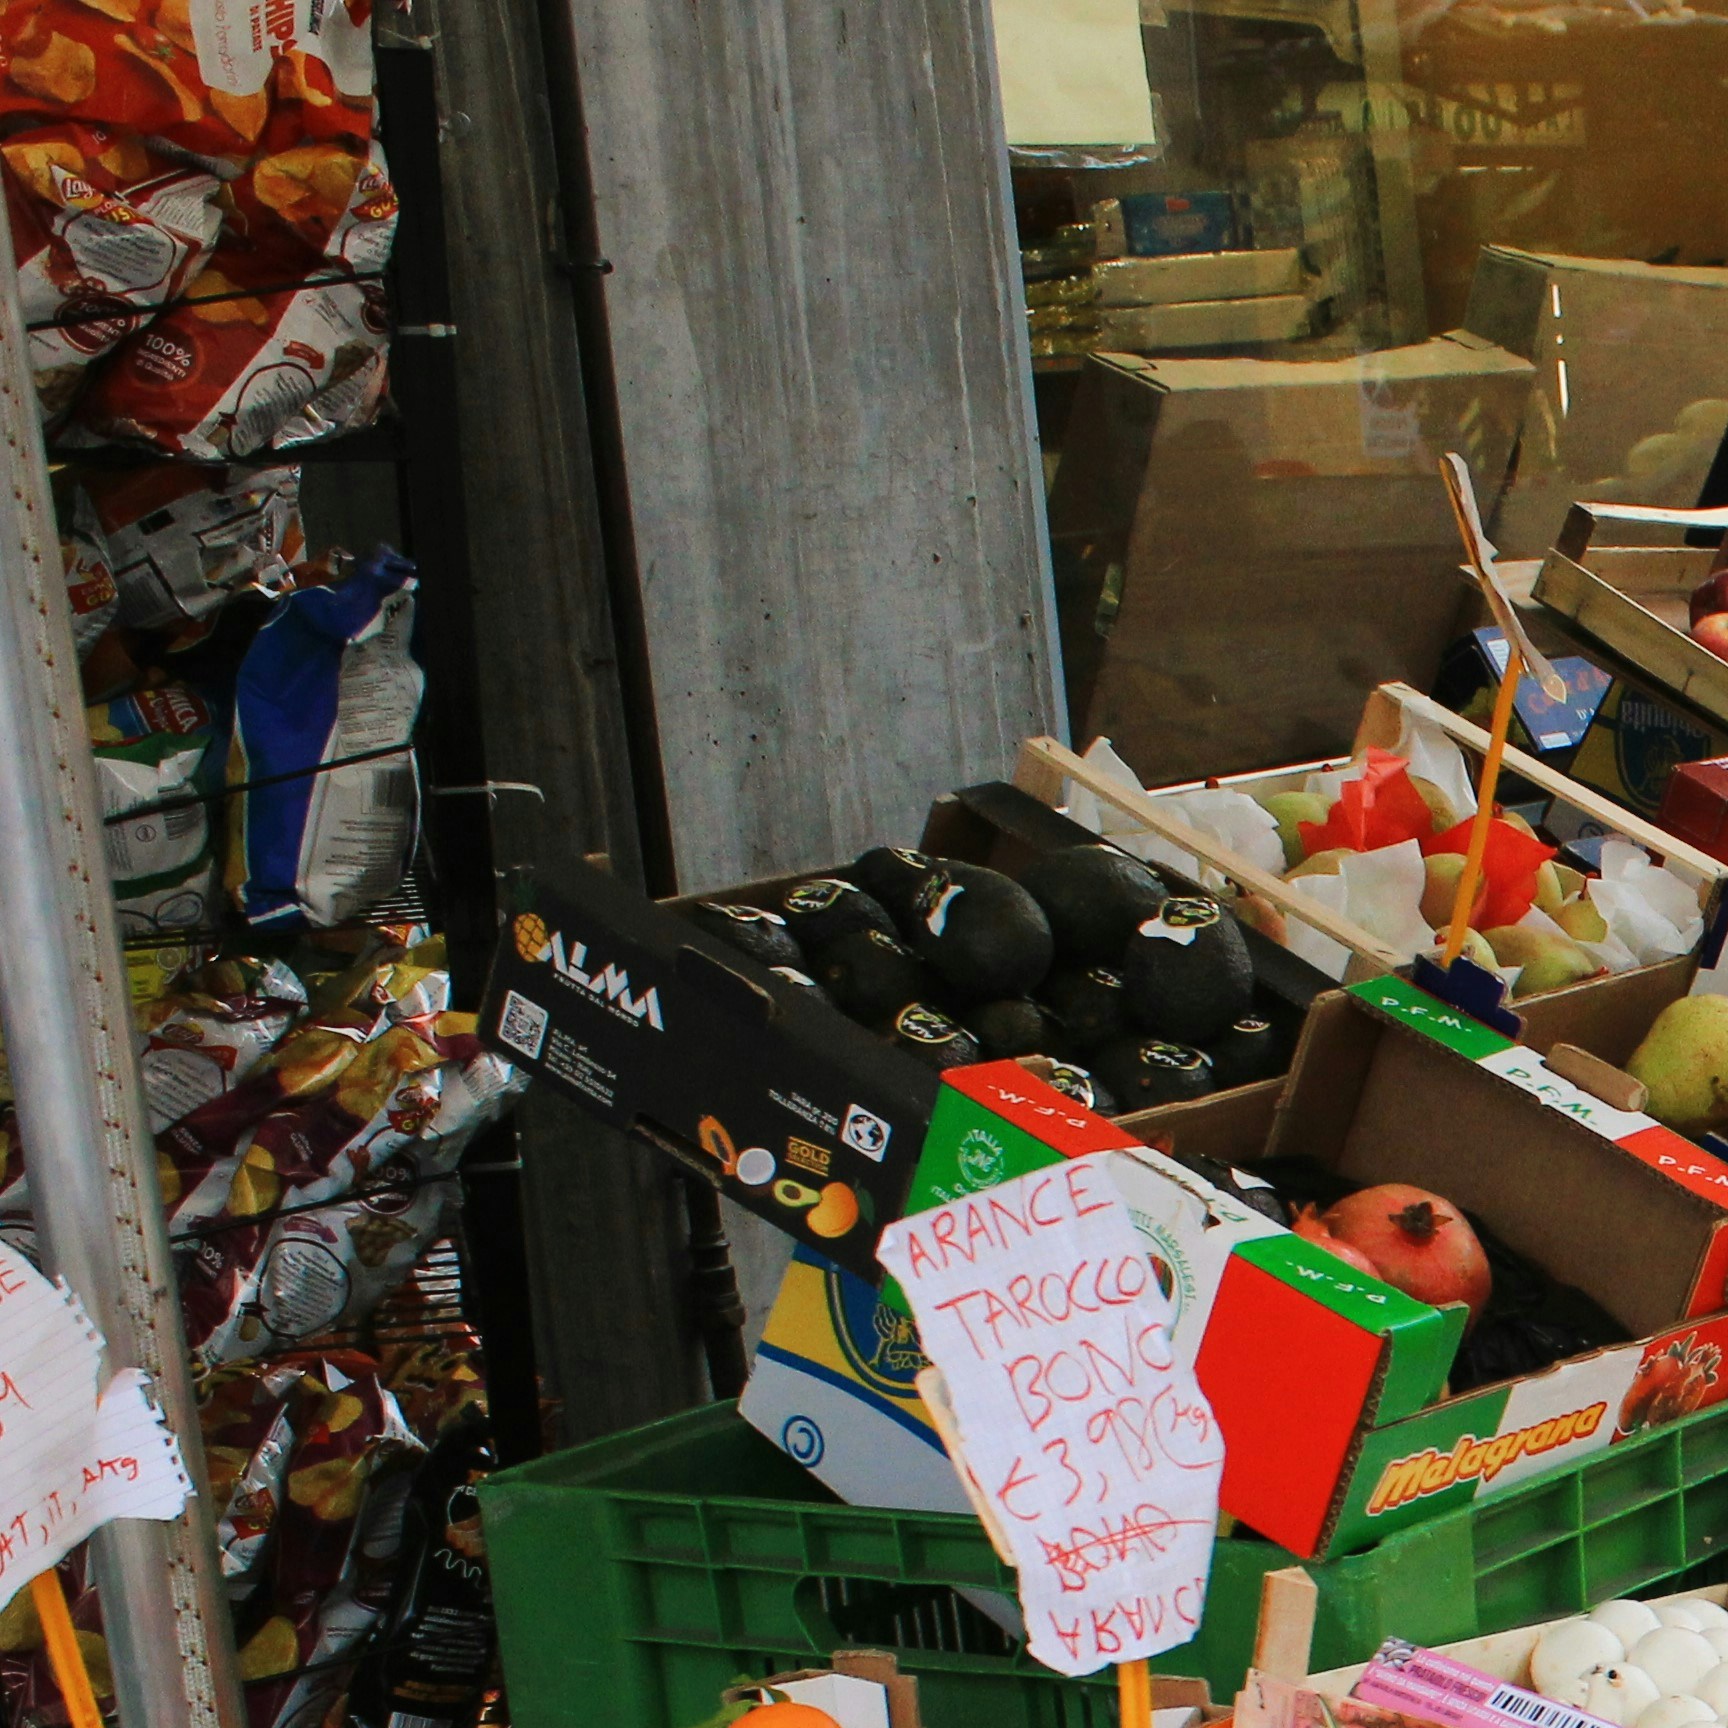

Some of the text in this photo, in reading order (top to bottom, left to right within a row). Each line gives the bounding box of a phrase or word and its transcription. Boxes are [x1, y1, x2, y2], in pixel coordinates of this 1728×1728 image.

[145, 333, 192, 367] 100%
[537, 930, 665, 1032] ALMA
[1382, 994, 1473, 1034] P.F.M.
[1505, 1066, 1599, 1127] P.F.M.
[788, 1142, 832, 1166] GOLD
[904, 1162, 1117, 1279] ARANCE
[934, 1253, 1148, 1360] TAROCCO
[1365, 1400, 1608, 1519] Melagrana
